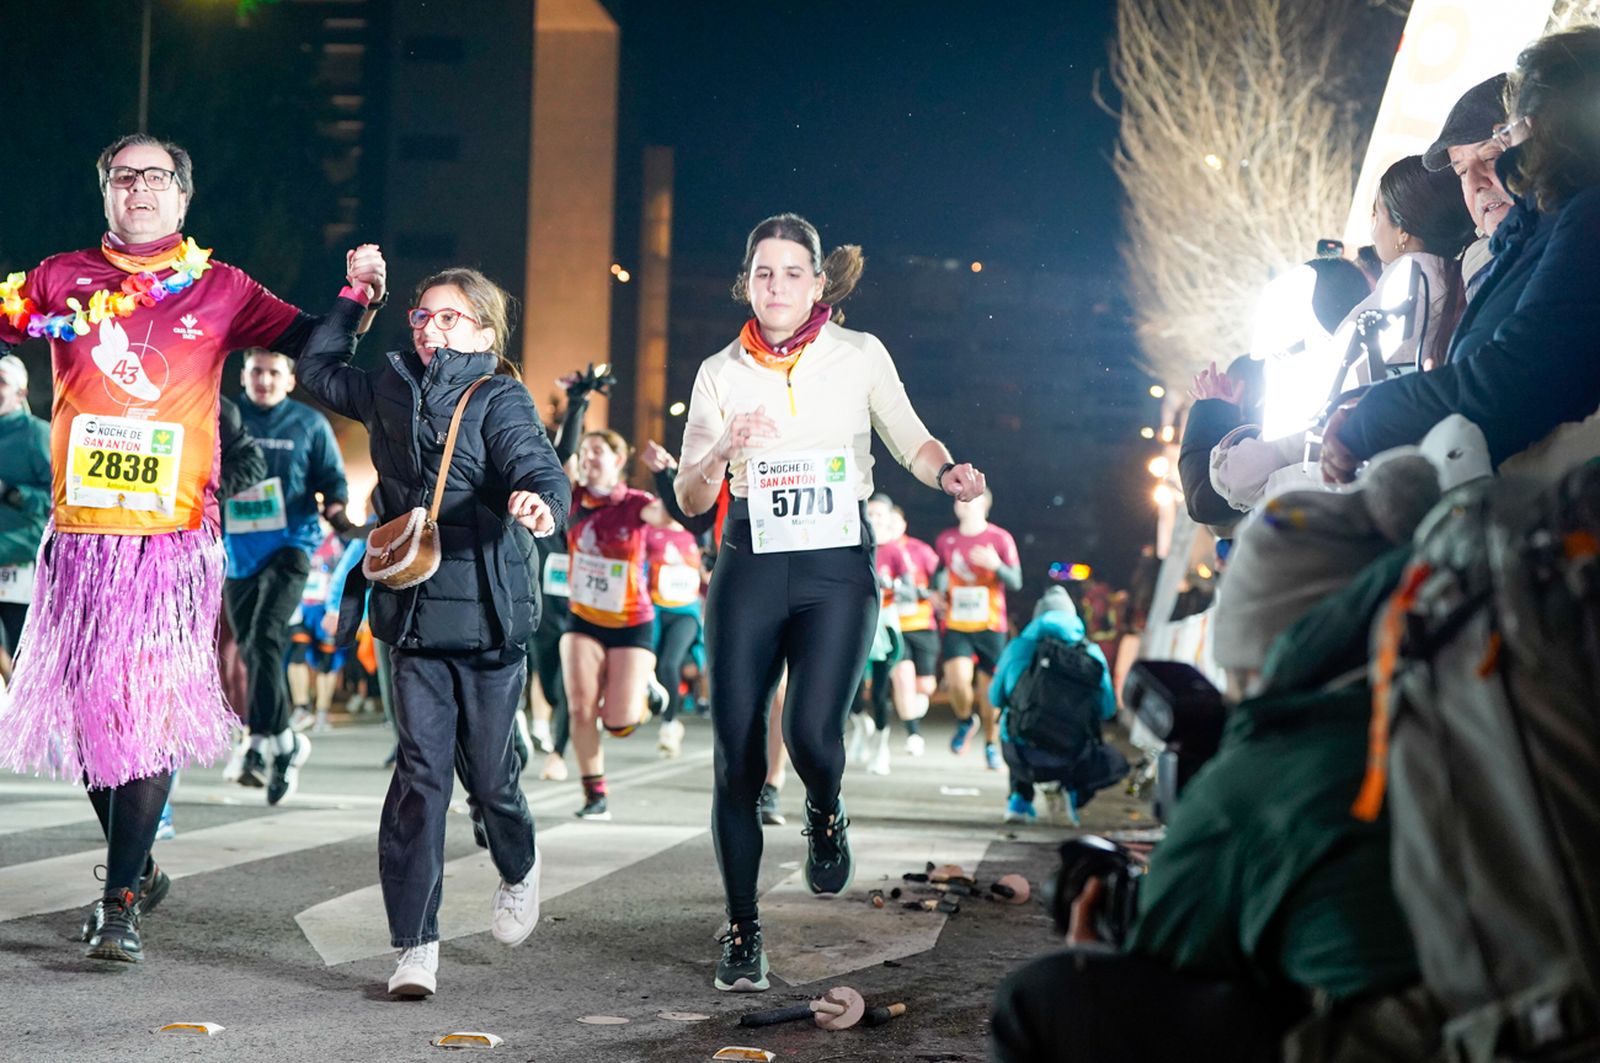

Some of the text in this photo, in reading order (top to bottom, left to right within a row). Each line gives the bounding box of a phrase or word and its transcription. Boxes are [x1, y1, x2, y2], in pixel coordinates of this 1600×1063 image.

[111, 359, 139, 385] 43
[97, 427, 142, 440] NOCHE DE
[83, 437, 103, 447] SAN
[88, 450, 159, 484] 2838
[770, 463, 815, 474] NOCHE DE
[760, 477, 779, 489] SAN
[772, 486, 834, 518] 5770
